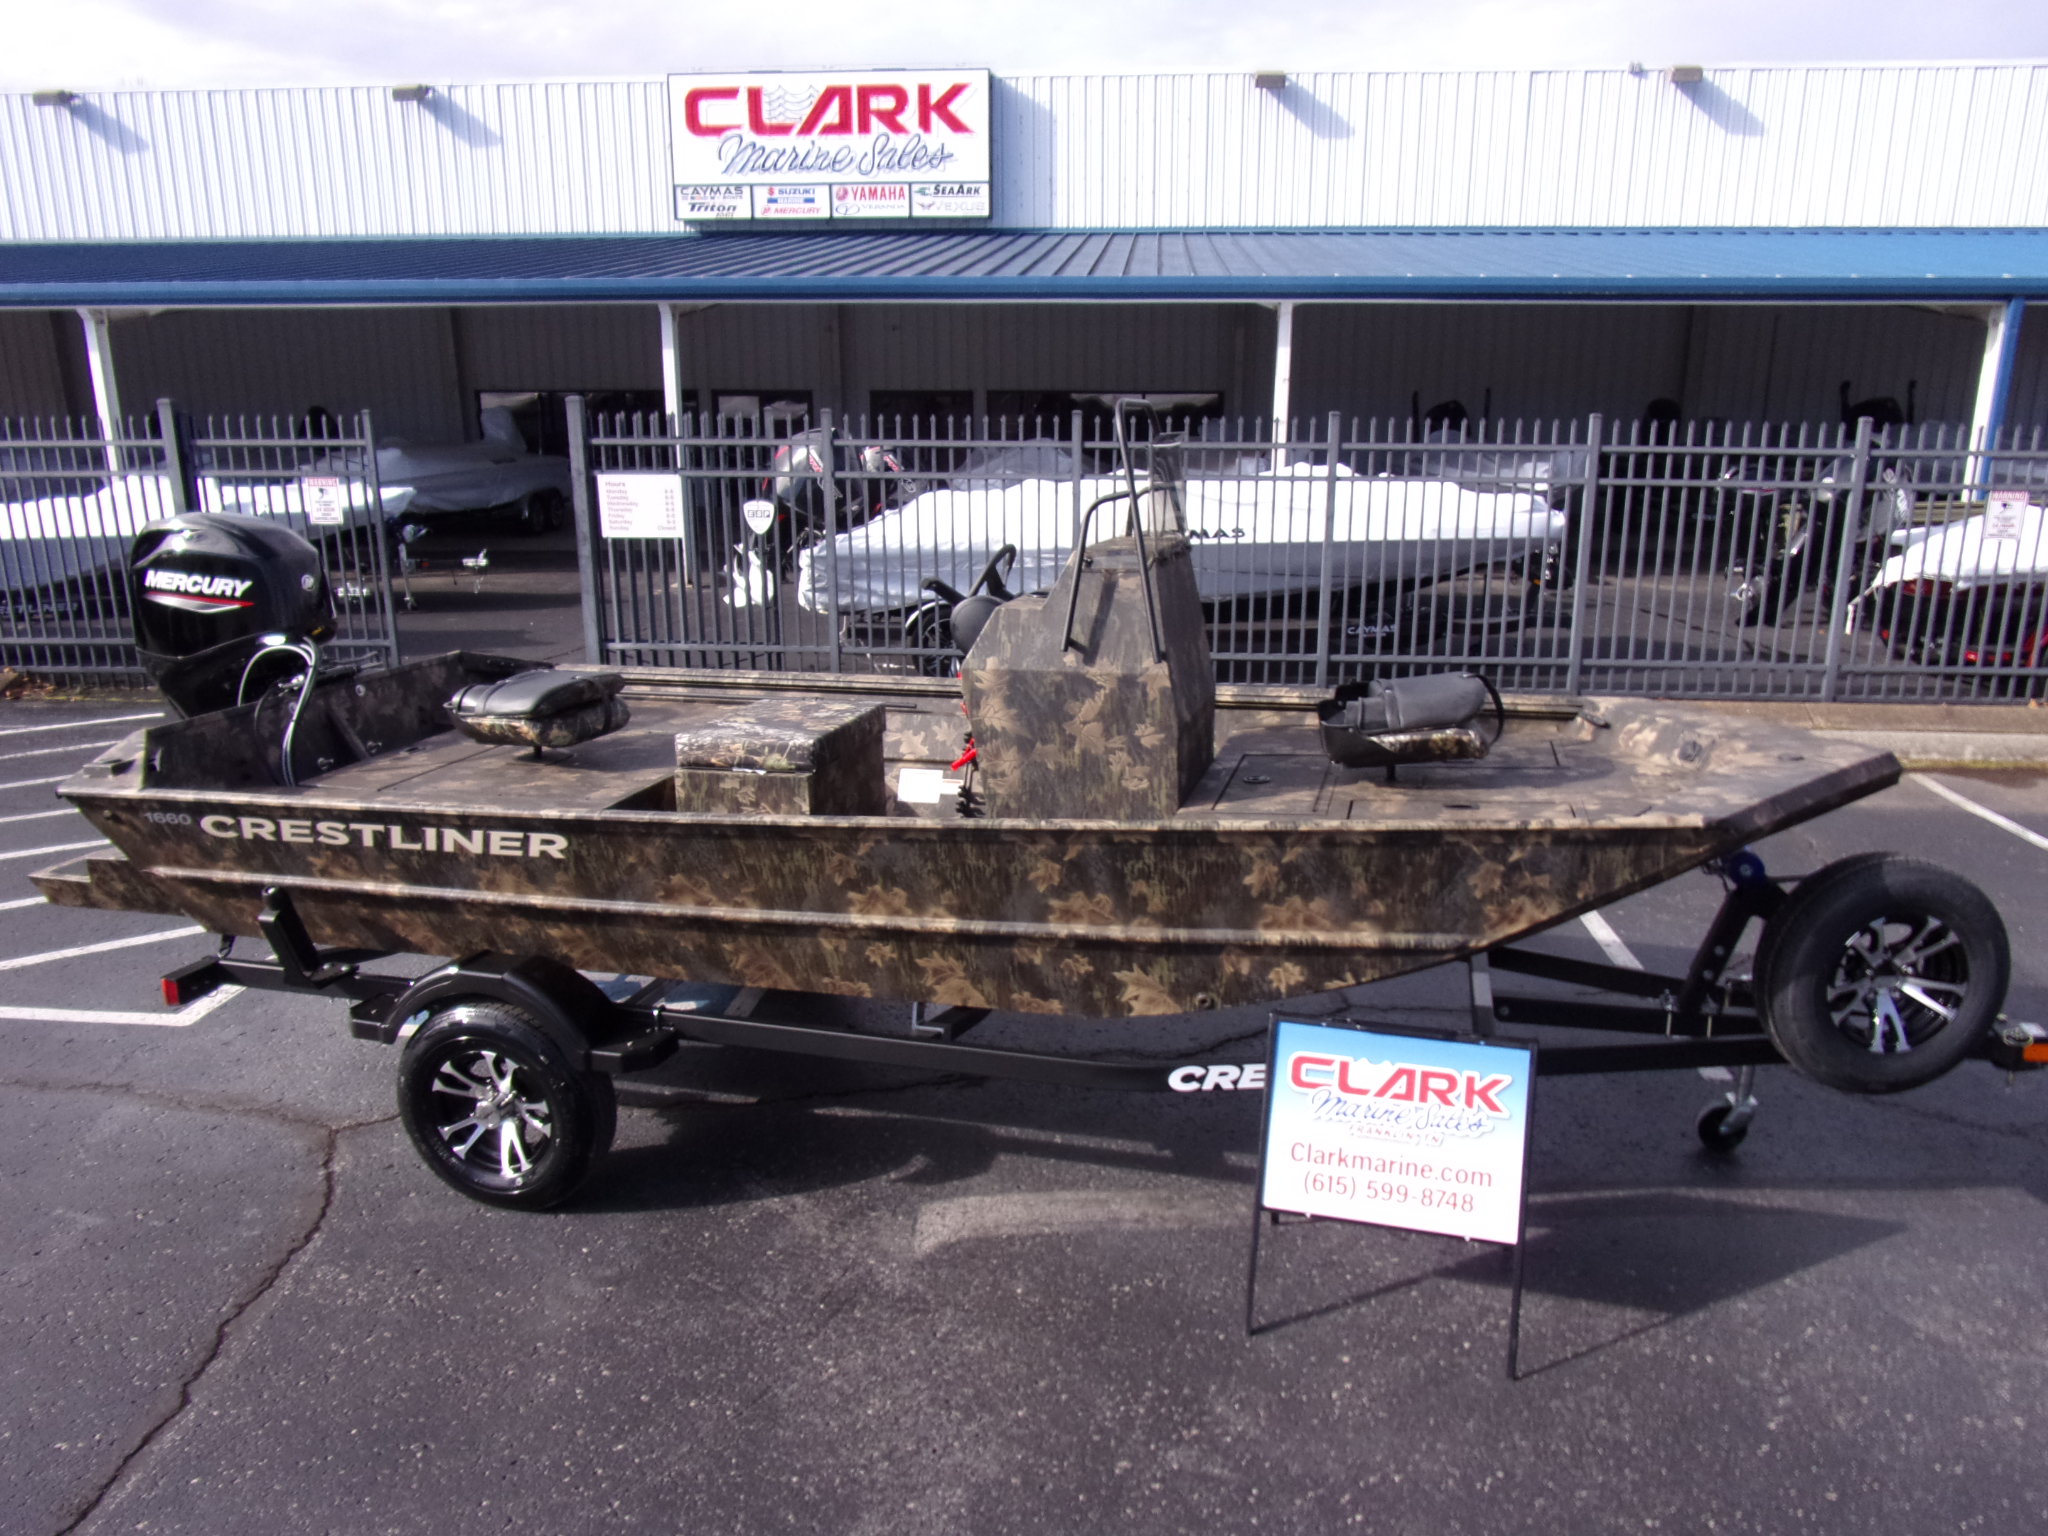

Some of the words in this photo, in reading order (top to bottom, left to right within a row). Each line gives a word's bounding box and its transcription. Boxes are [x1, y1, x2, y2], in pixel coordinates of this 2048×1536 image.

[684, 83, 975, 136] CLARK
[718, 133, 852, 175] Marine
[859, 132, 954, 175] Sales
[680, 186, 743, 196] CAYMAS
[688, 202, 737, 212] Triton
[774, 206, 822, 214] MERCURY
[851, 186, 906, 201] YAMAHA
[144, 569, 253, 598] MERCURY
[144, 811, 191, 826] 1660
[200, 814, 569, 860] CRESTLINER
[1290, 1055, 1504, 1113] CLARK
[1312, 1089, 1412, 1125] Marine
[1415, 1103, 1489, 1132] Sales
[1290, 1142, 1492, 1187] Clarkmarine.com
[1304, 1170, 1356, 1200] (615)
[1366, 1180, 1474, 1212] 599-8748
